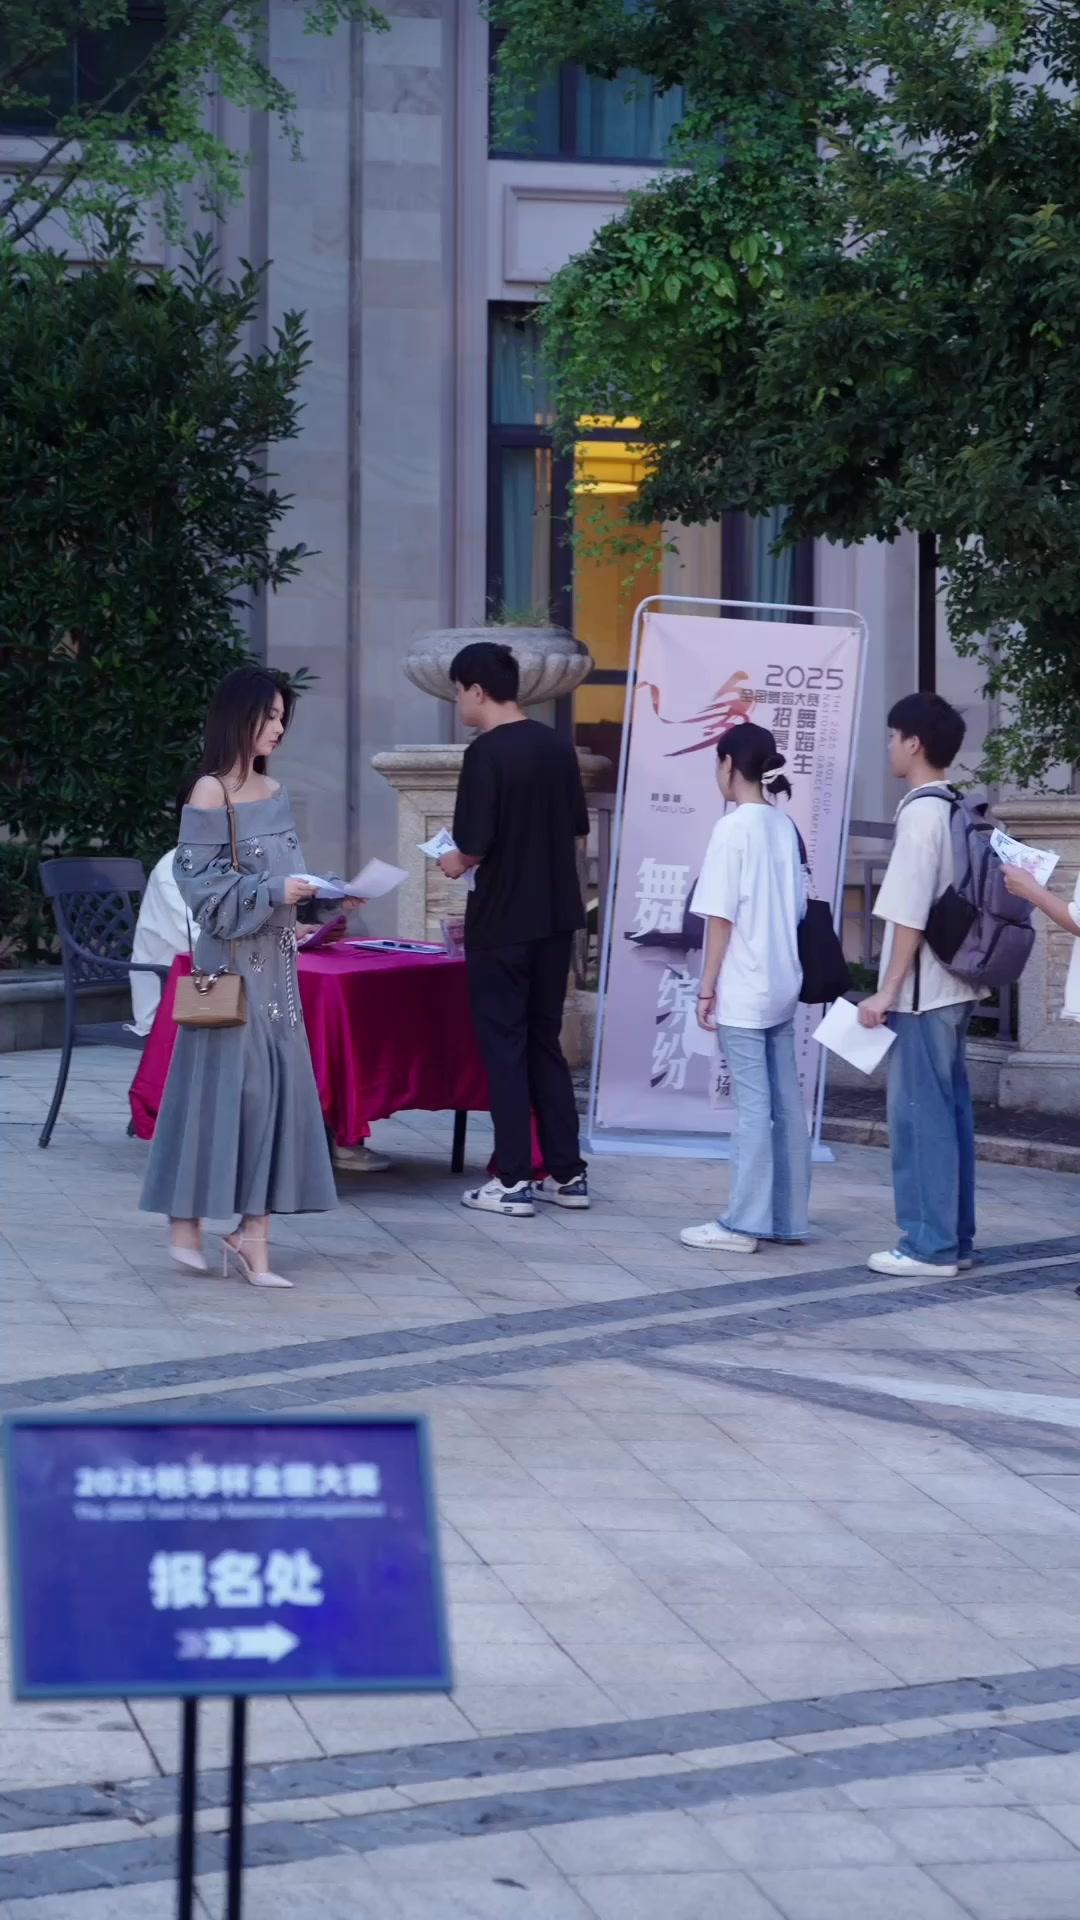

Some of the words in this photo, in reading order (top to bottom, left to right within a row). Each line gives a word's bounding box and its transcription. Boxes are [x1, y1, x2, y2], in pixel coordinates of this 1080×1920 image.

[765, 664, 844, 690] 2025
[793, 708, 817, 775] 舞蹈生
[148, 1547, 325, 1610] 报名处
